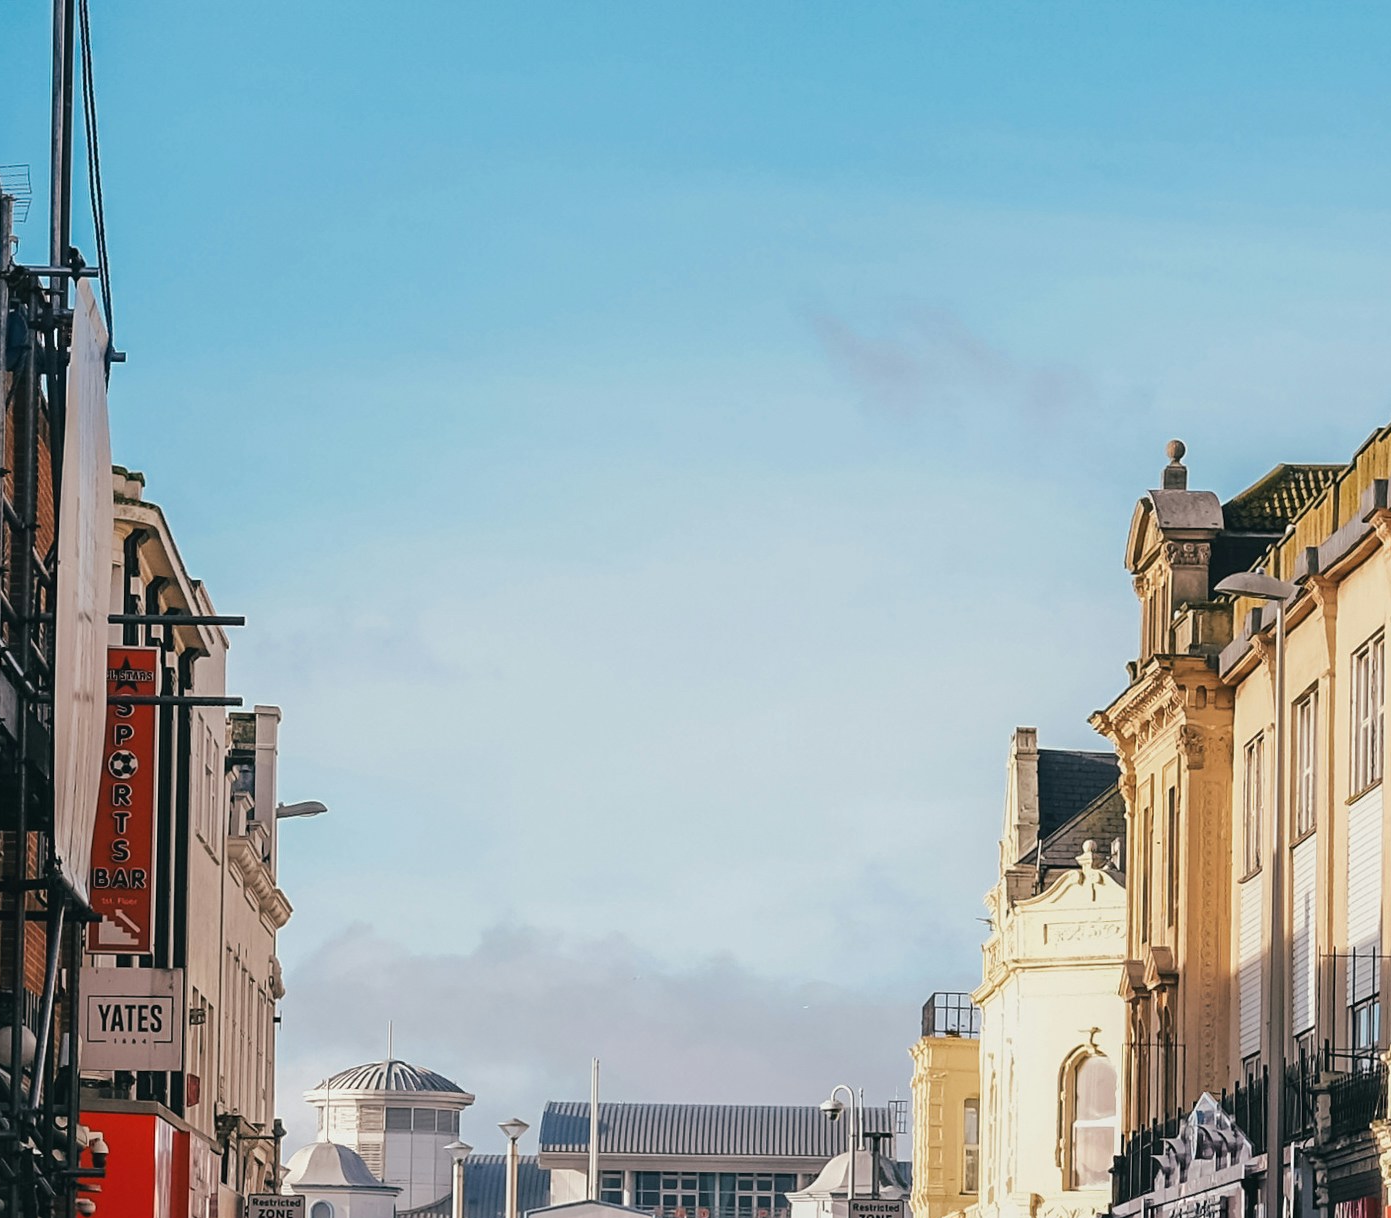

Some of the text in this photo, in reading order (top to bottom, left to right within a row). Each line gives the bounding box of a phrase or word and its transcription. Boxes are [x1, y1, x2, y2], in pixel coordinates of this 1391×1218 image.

[118, 670, 154, 682] STARS
[93, 867, 147, 890] BAR
[98, 1004, 163, 1033] YATES
[252, 1198, 301, 1208] Restricted
[852, 1203, 900, 1212] Restricted
[258, 1208, 294, 1218] ZONE
